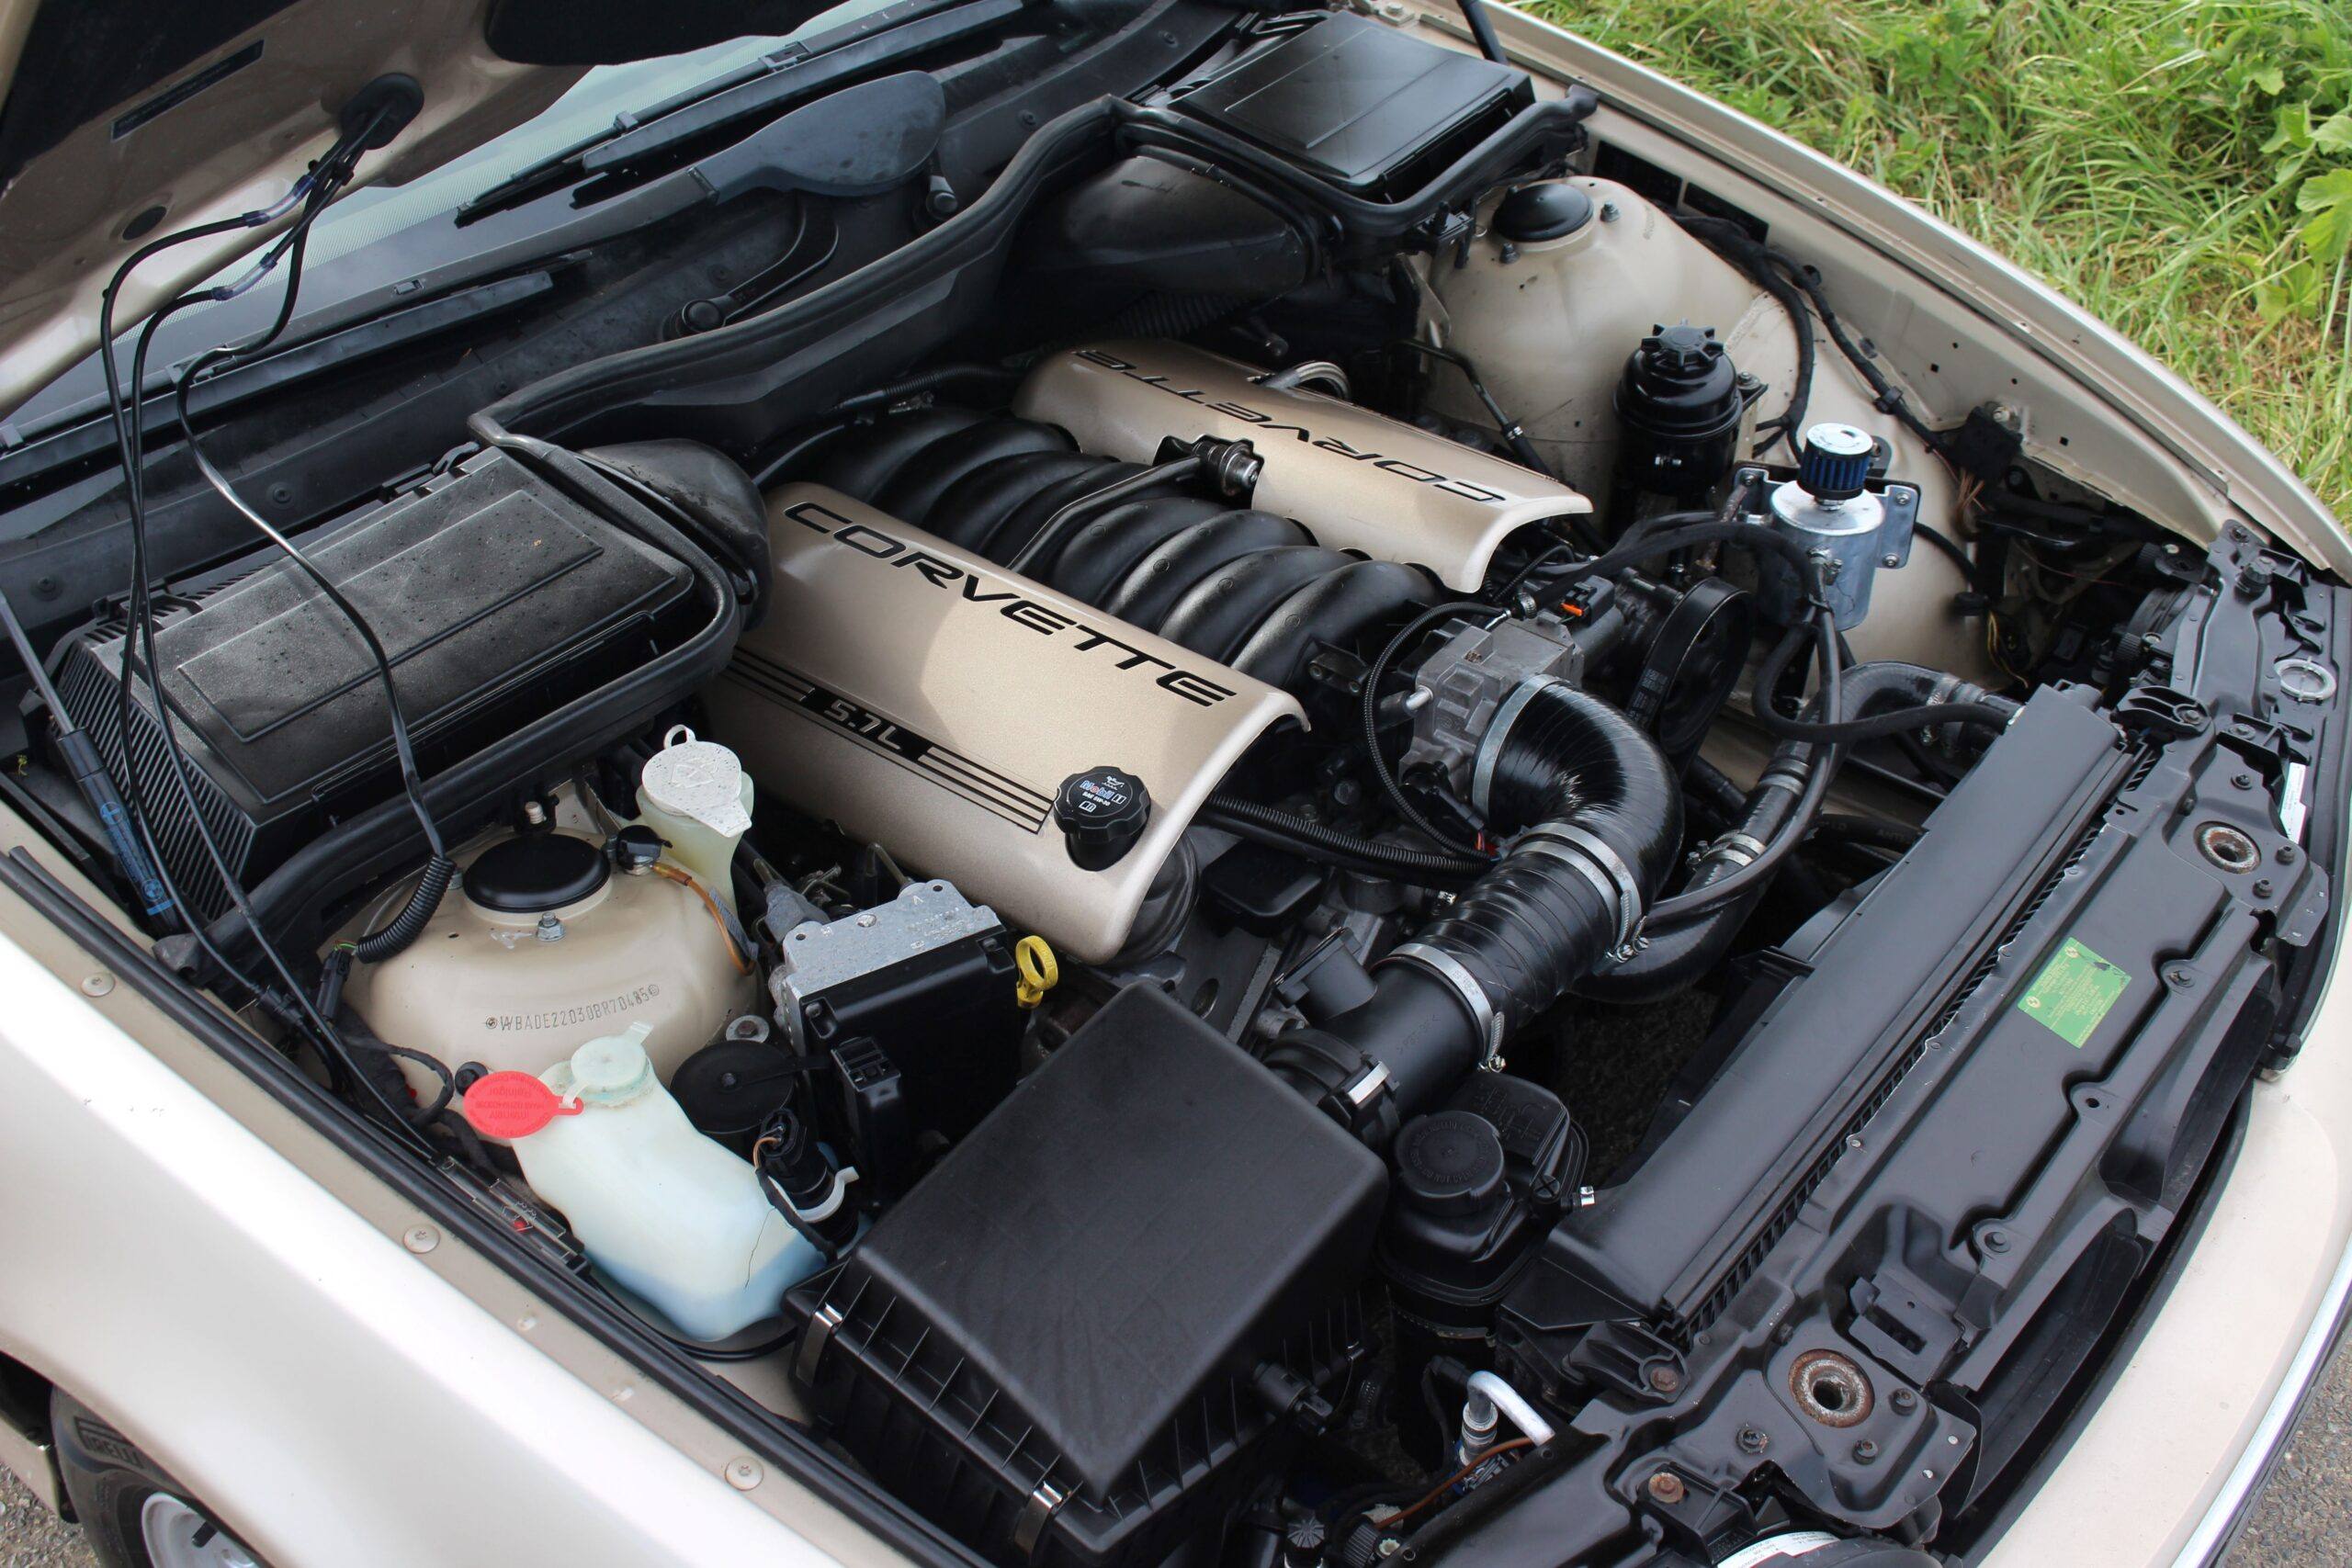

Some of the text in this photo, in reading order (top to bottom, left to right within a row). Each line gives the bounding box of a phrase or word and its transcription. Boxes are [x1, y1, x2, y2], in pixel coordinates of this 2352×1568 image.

[1073, 349, 1505, 502] CORVETTE
[785, 502, 1237, 707] CORVETTE
[823, 700, 903, 752] 5.7L
[1080, 780, 1114, 798] Mobil
